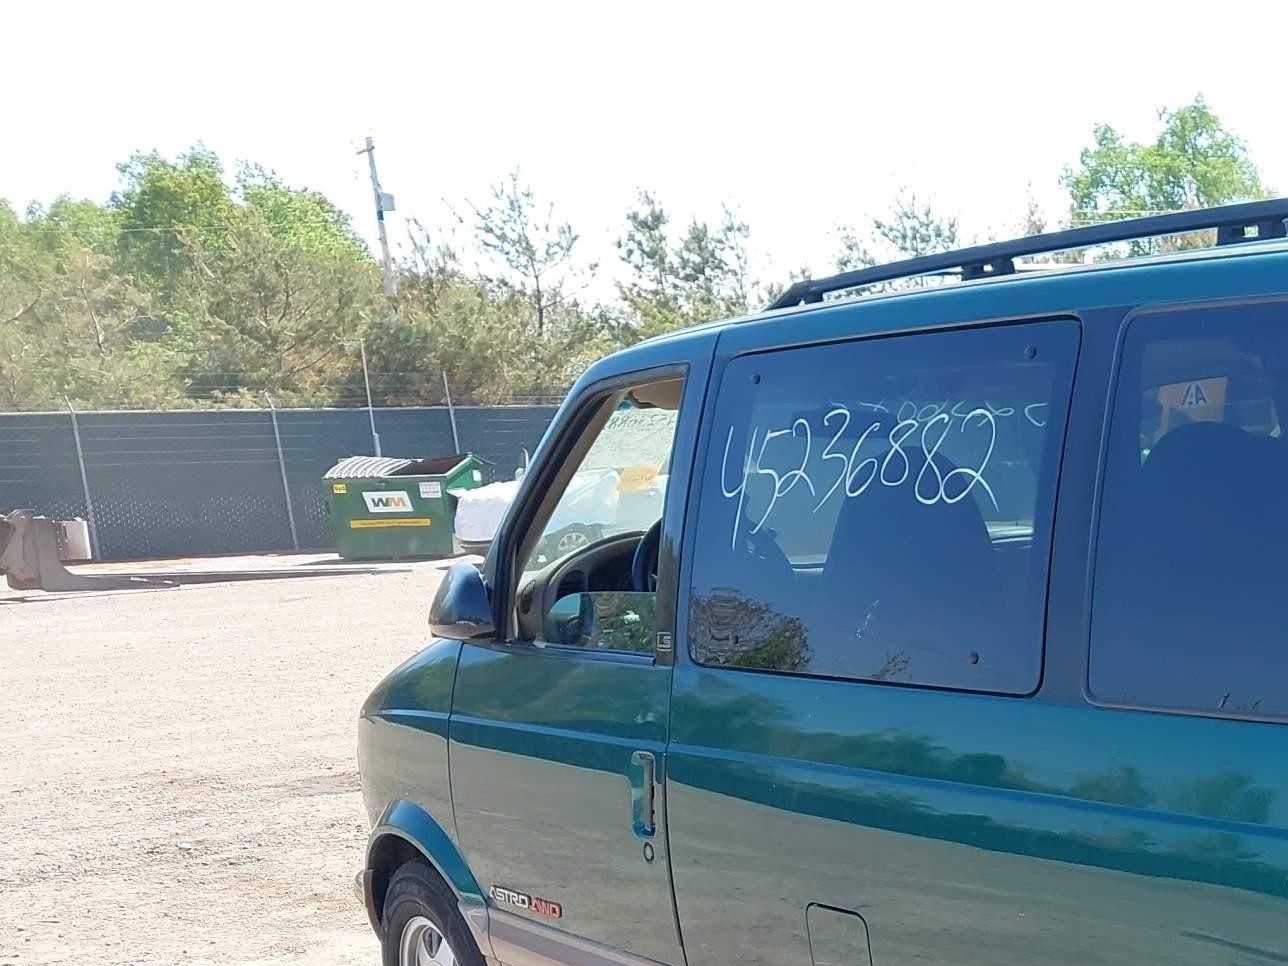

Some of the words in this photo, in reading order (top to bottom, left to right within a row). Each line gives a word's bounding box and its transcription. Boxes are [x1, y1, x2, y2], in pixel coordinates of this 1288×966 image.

[721, 408, 999, 551] 45236882
[371, 497, 407, 508] WM
[488, 885, 531, 909] ASTRO
[531, 897, 562, 918] AWD
